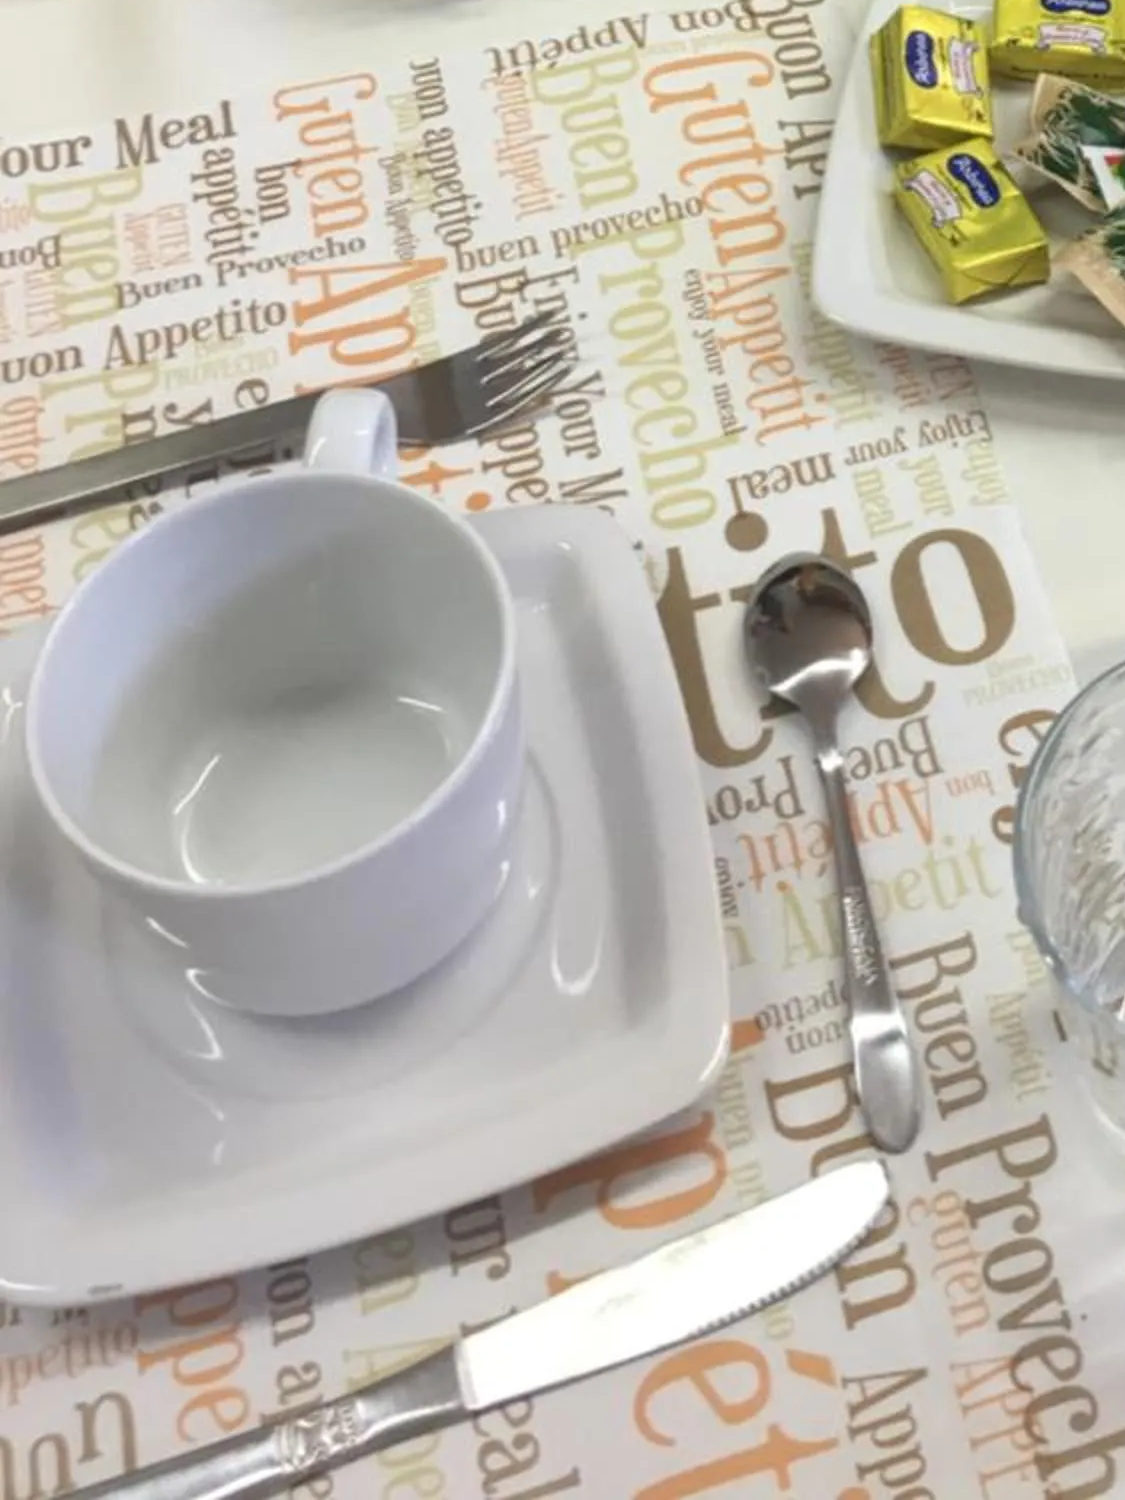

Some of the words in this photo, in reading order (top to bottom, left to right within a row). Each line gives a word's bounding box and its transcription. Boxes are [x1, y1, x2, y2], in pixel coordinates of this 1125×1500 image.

[0, 134, 92, 178] our
[114, 100, 237, 169] Meal
[273, 72, 380, 238] Guten
[412, 127, 484, 248] appetito
[530, 46, 642, 210] Buen
[643, 50, 788, 267] Guten
[27, 167, 143, 329] Buen
[190, 146, 260, 265] appétit
[254, 161, 292, 223] bon
[456, 235, 541, 273] buen
[550, 193, 703, 248] provecho
[116, 272, 202, 310] Buen
[217, 236, 366, 287] Provecho
[0, 344, 83, 384] uon
[103, 297, 288, 372] Appetito
[568, 217, 740, 531] Provecho
[682, 268, 713, 340] enjoy
[712, 381, 748, 437] meal
[704, 266, 829, 447] Appetit
[549, 369, 607, 460] Your
[844, 428, 910, 469] your
[917, 409, 993, 450] Enjoy
[726, 452, 837, 517] meal
[887, 930, 989, 1121] Buen
